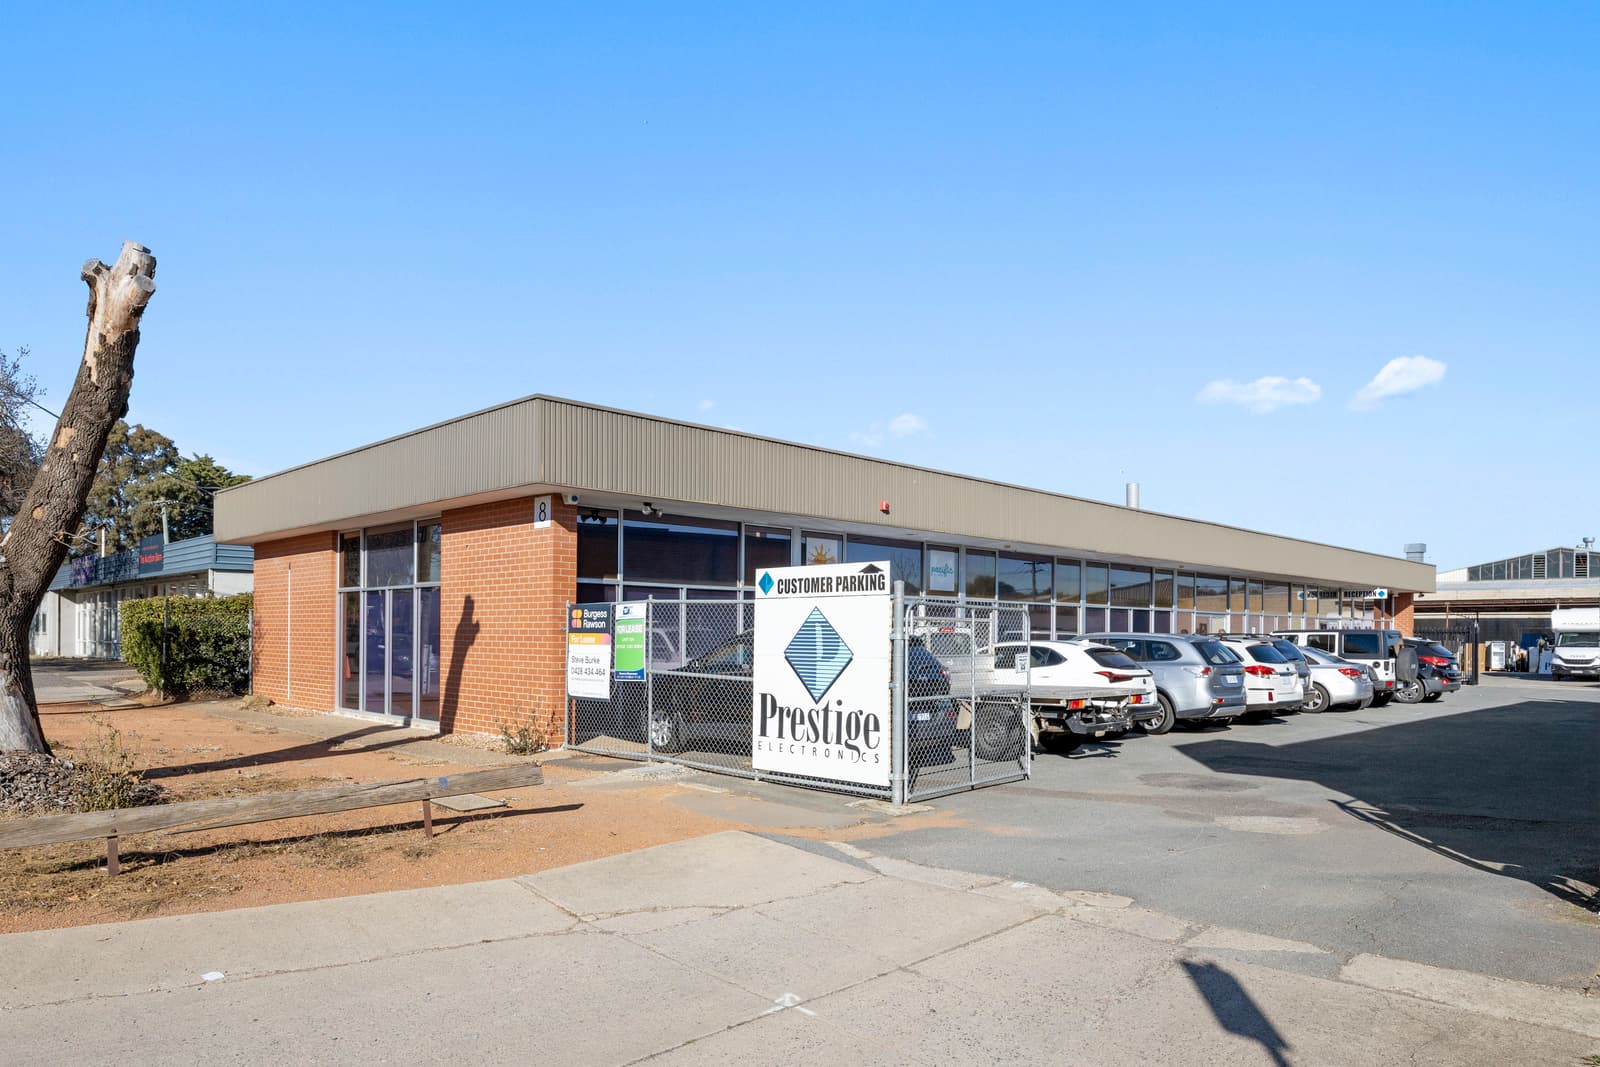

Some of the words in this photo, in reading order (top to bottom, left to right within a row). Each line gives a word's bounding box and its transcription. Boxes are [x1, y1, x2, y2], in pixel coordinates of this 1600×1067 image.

[539, 502, 546, 522] 8
[777, 577, 833, 594] CUSTOMER
[836, 573, 885, 593] PARKING
[583, 620, 605, 628] Rawson
[584, 609, 607, 620] Burgess
[585, 656, 600, 665] Burke
[758, 693, 880, 763] Prestige
[758, 741, 880, 763] ELECTRONICS
